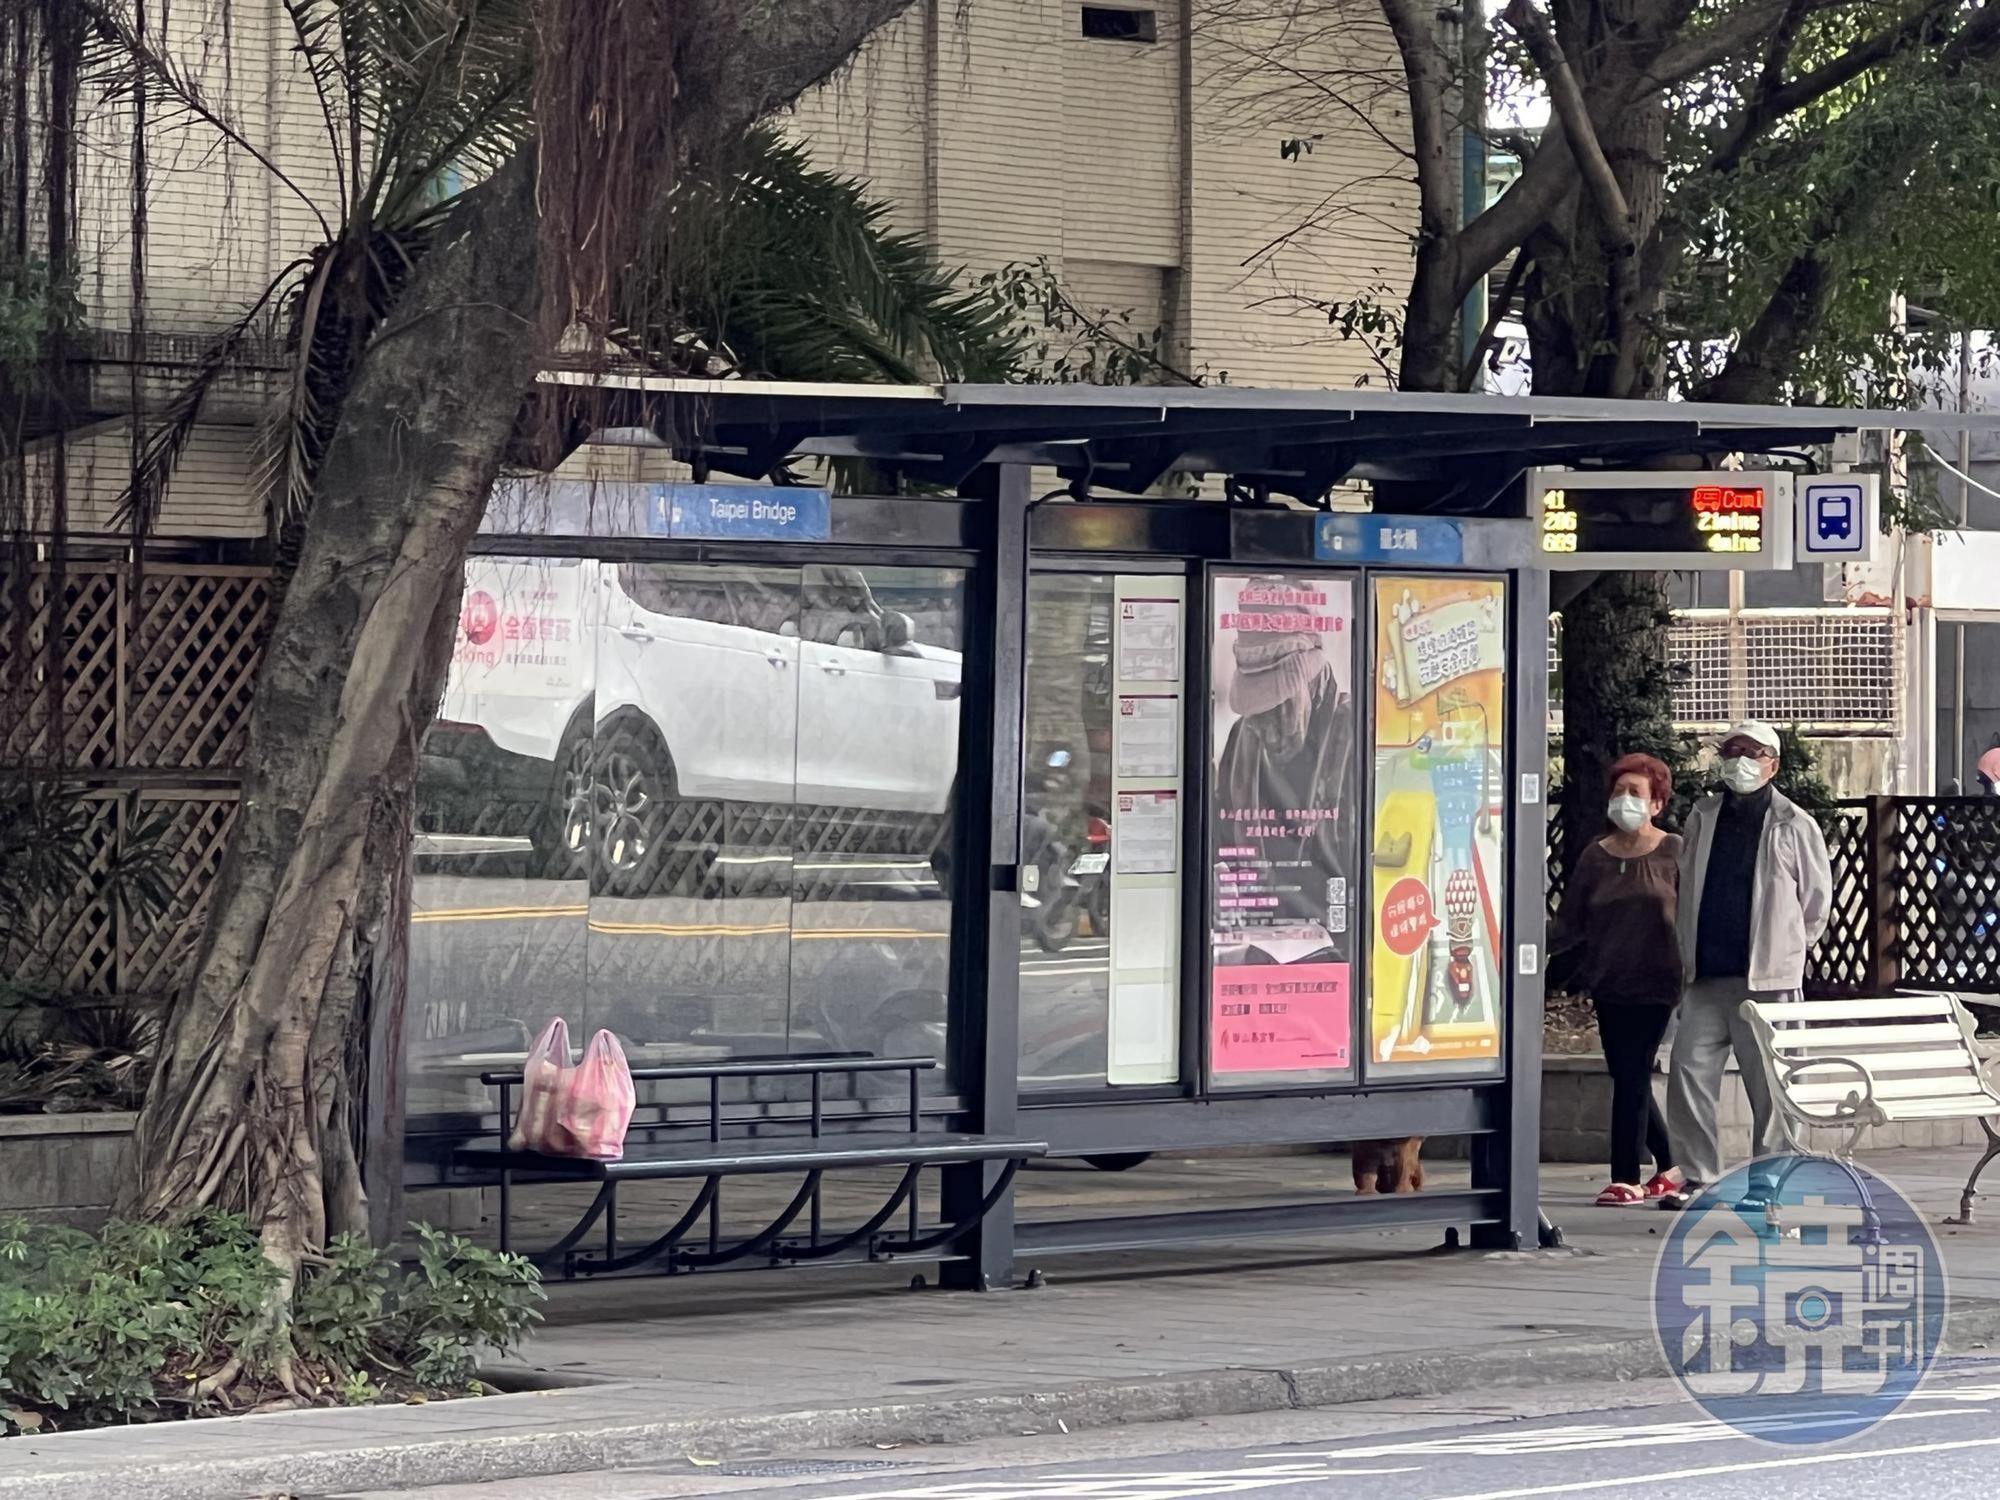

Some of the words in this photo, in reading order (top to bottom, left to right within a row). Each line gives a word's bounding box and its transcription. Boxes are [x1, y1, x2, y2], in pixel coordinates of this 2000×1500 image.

[1543, 490, 1566, 509] 41
[709, 498, 749, 523] Taipei
[752, 500, 797, 525] Bridge
[1707, 532, 1761, 552] 4mins
[1123, 603, 1134, 615] 41
